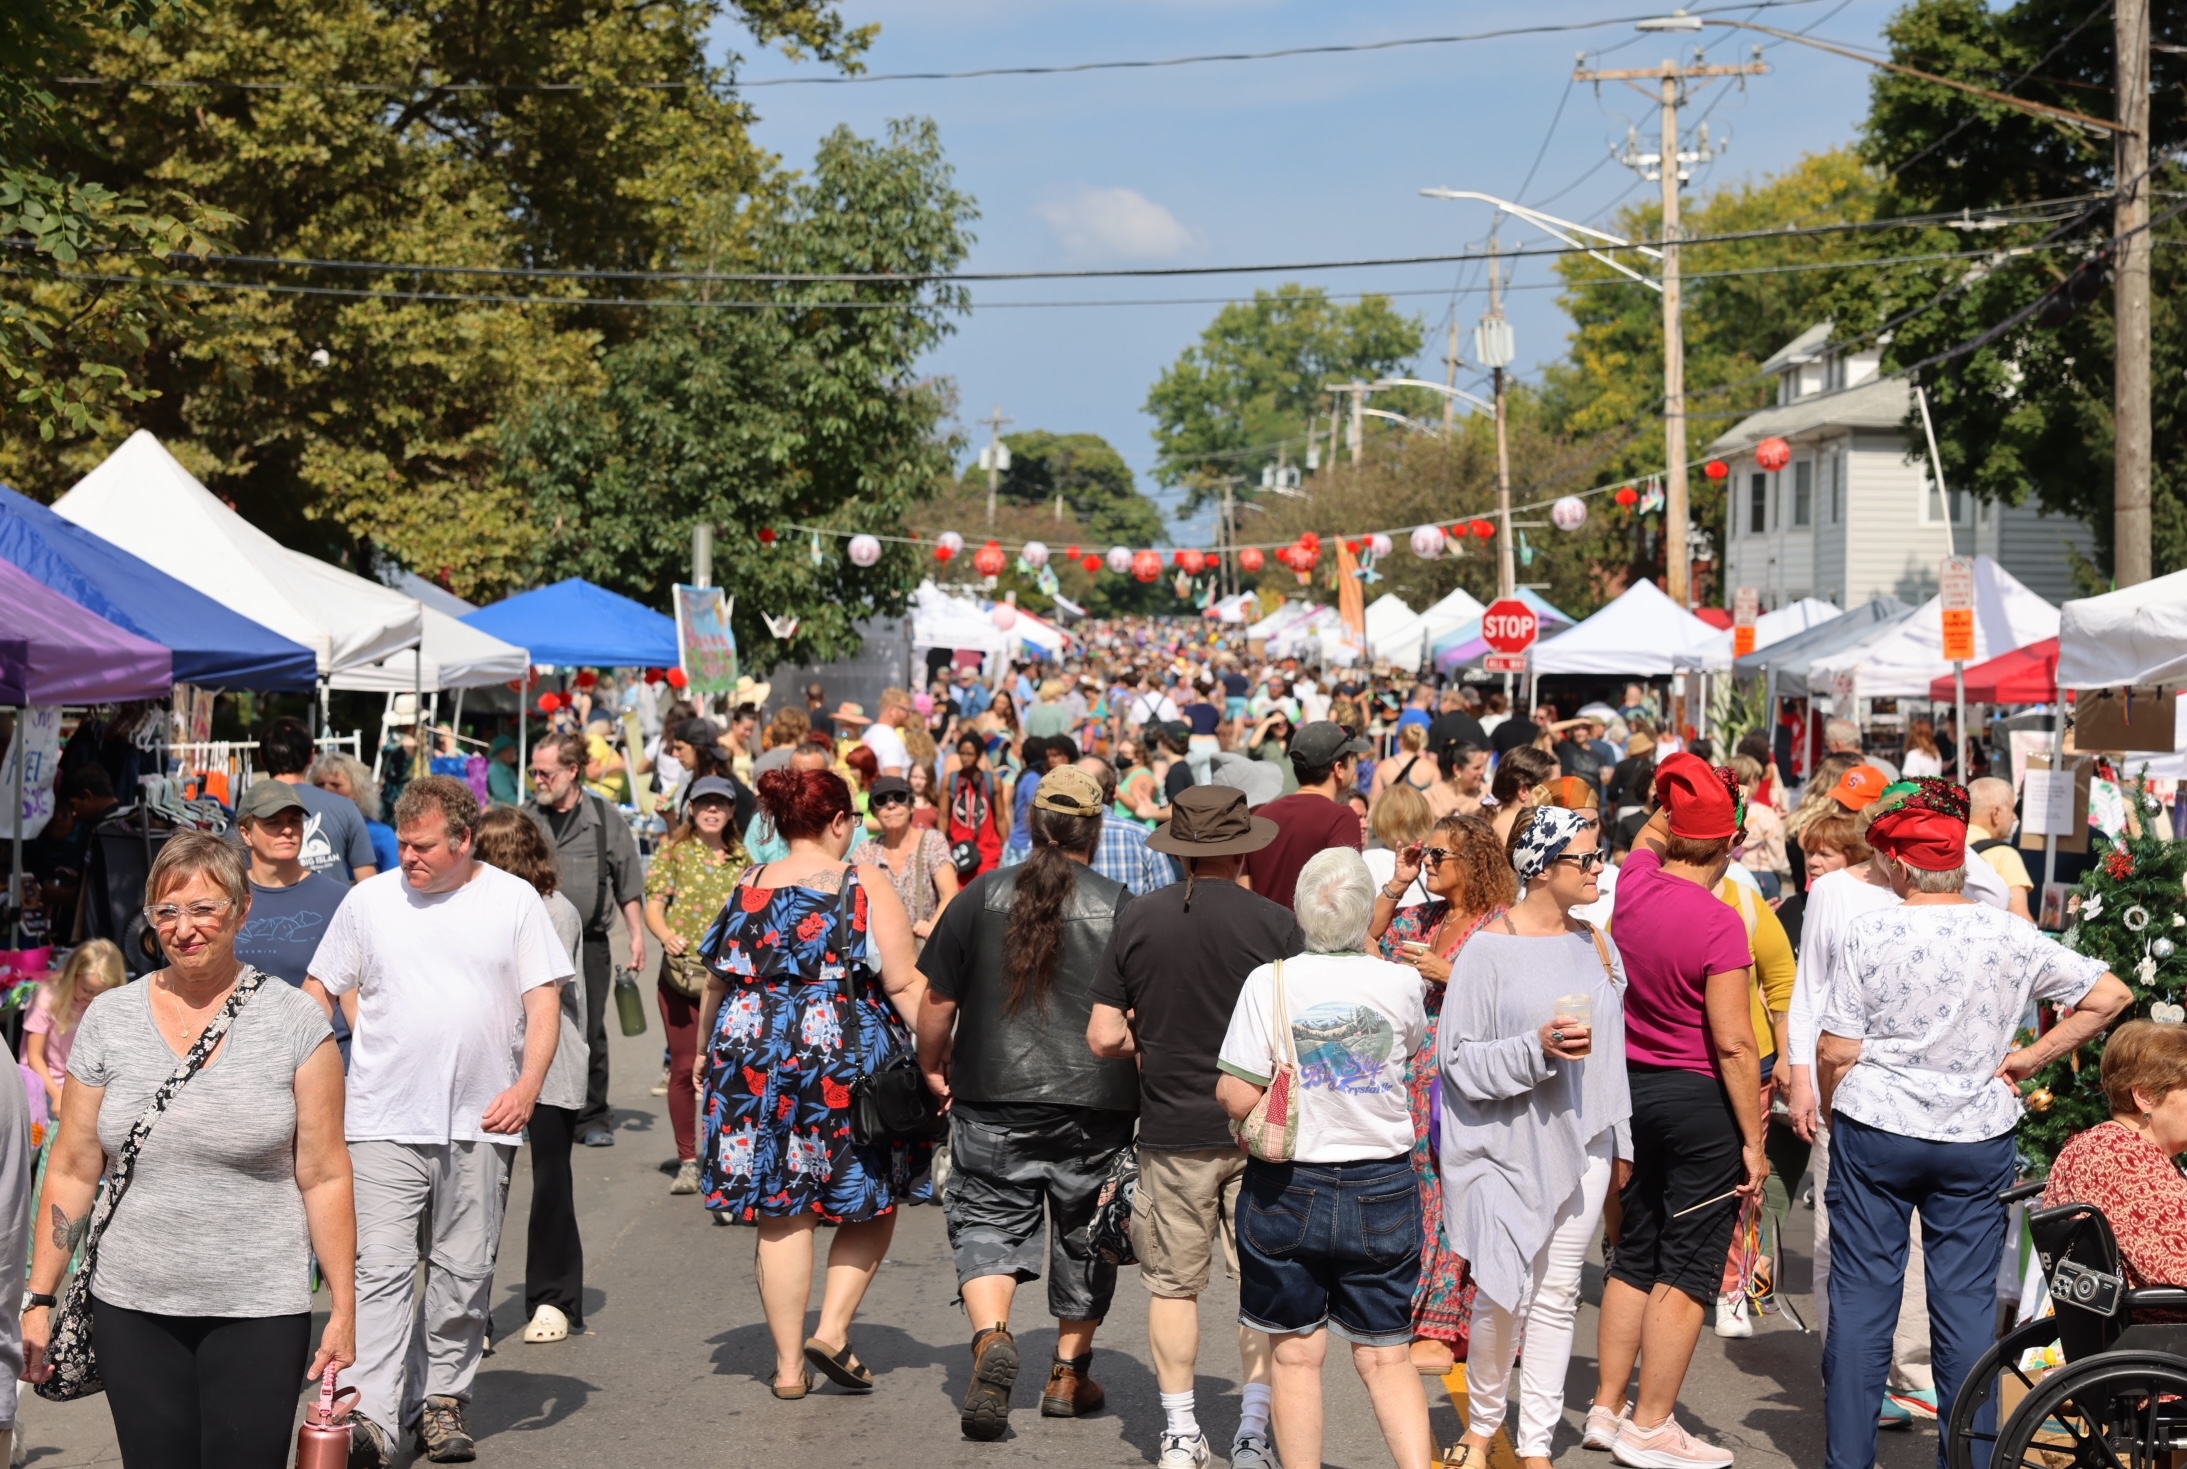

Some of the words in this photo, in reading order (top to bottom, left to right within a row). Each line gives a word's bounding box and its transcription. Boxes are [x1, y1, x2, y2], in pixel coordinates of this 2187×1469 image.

[1484, 615, 1535, 639] STOP
[1488, 658, 1504, 669] ALL
[299, 857, 315, 867] BIG
[316, 854, 341, 864] ISLAN
[1300, 1056, 1338, 1091] Big
[1339, 1054, 1389, 1086] Sky
